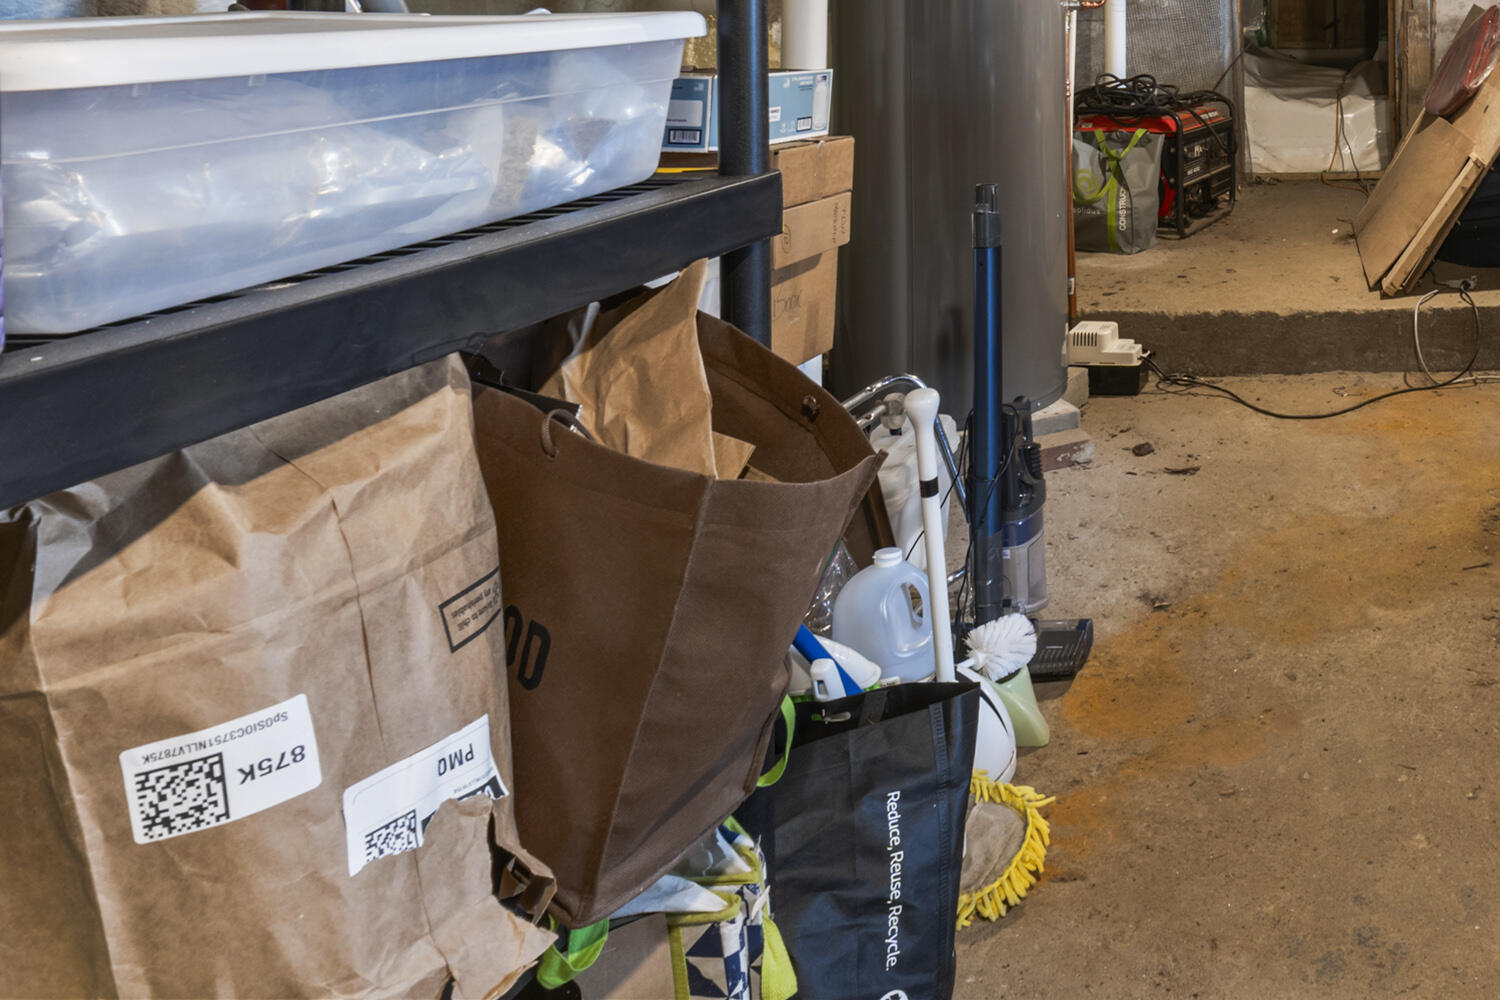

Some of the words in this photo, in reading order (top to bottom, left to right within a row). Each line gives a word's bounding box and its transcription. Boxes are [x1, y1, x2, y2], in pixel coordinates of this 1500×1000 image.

[237, 745, 306, 785] 875K
[886, 790, 901, 851] Reduce,
[887, 850, 904, 904] Reuse,
[884, 904, 903, 971] Recycle.
